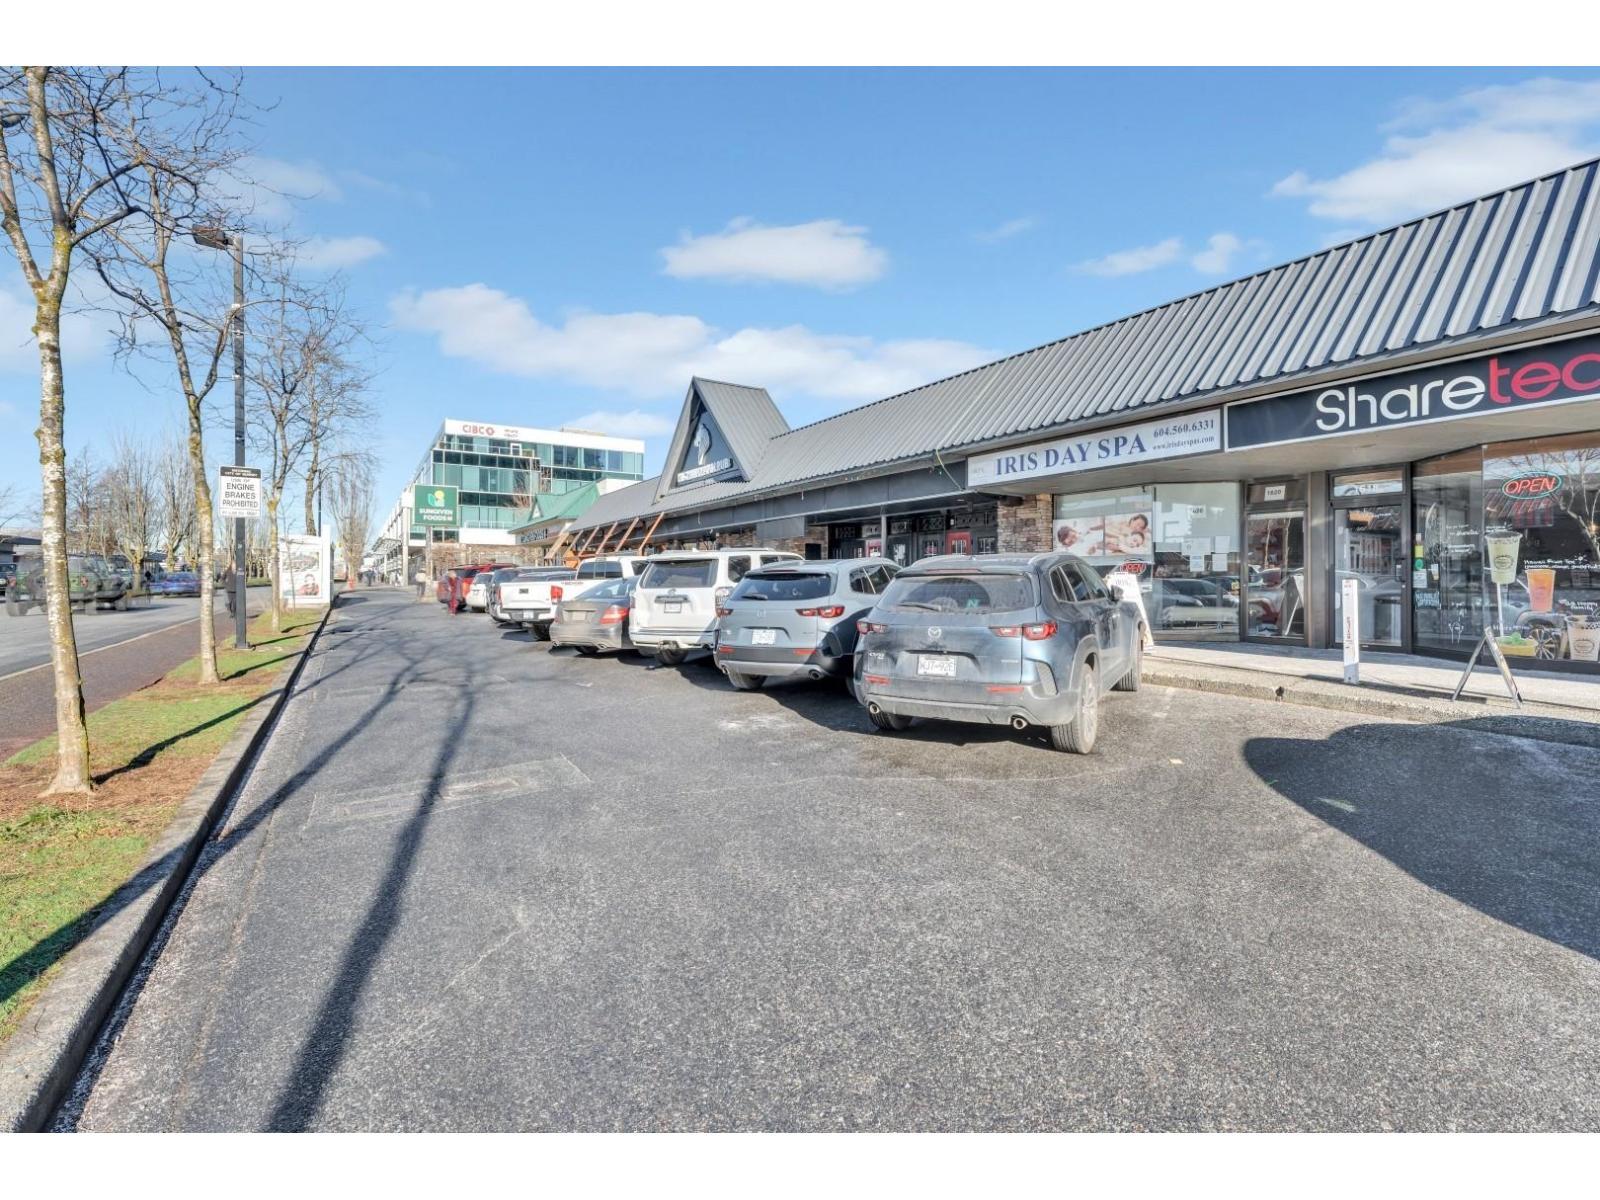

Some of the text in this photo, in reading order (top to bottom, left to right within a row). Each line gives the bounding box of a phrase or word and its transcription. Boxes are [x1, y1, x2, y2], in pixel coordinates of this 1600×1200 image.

[462, 424, 484, 435] CIBC
[1153, 419, 1214, 438] 604.560.6331
[996, 433, 1146, 475] IRIS DAY SPA
[226, 482, 255, 491] ENGINE
[1506, 477, 1556, 494] OPEN
[224, 491, 256, 500] BRAKES
[222, 499, 258, 508] PROHIBITED
